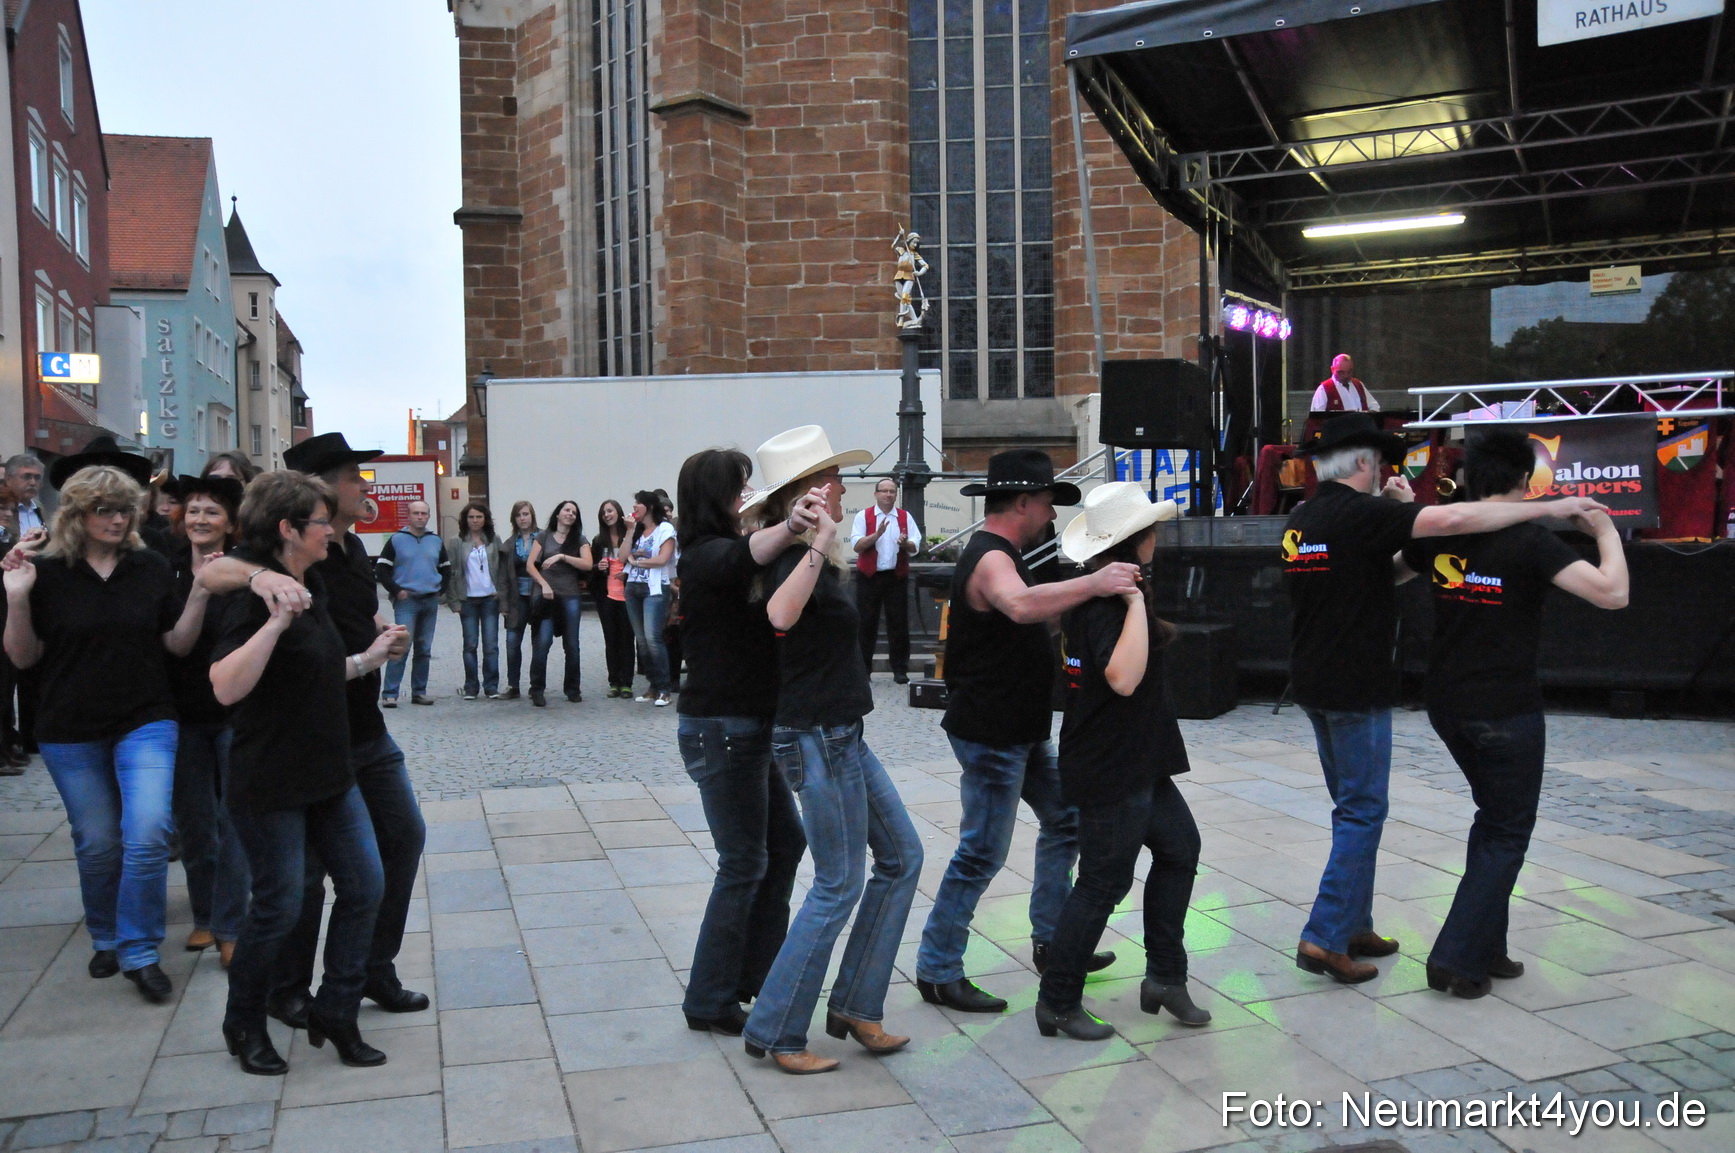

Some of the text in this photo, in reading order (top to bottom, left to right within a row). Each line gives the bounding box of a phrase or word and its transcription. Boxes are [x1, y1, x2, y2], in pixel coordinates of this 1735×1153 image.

[1575, 0, 1668, 29] RATHAUS
[157, 317, 178, 438] satzke
[367, 484, 421, 495] UMMEL
[378, 494, 422, 502] Getränke
